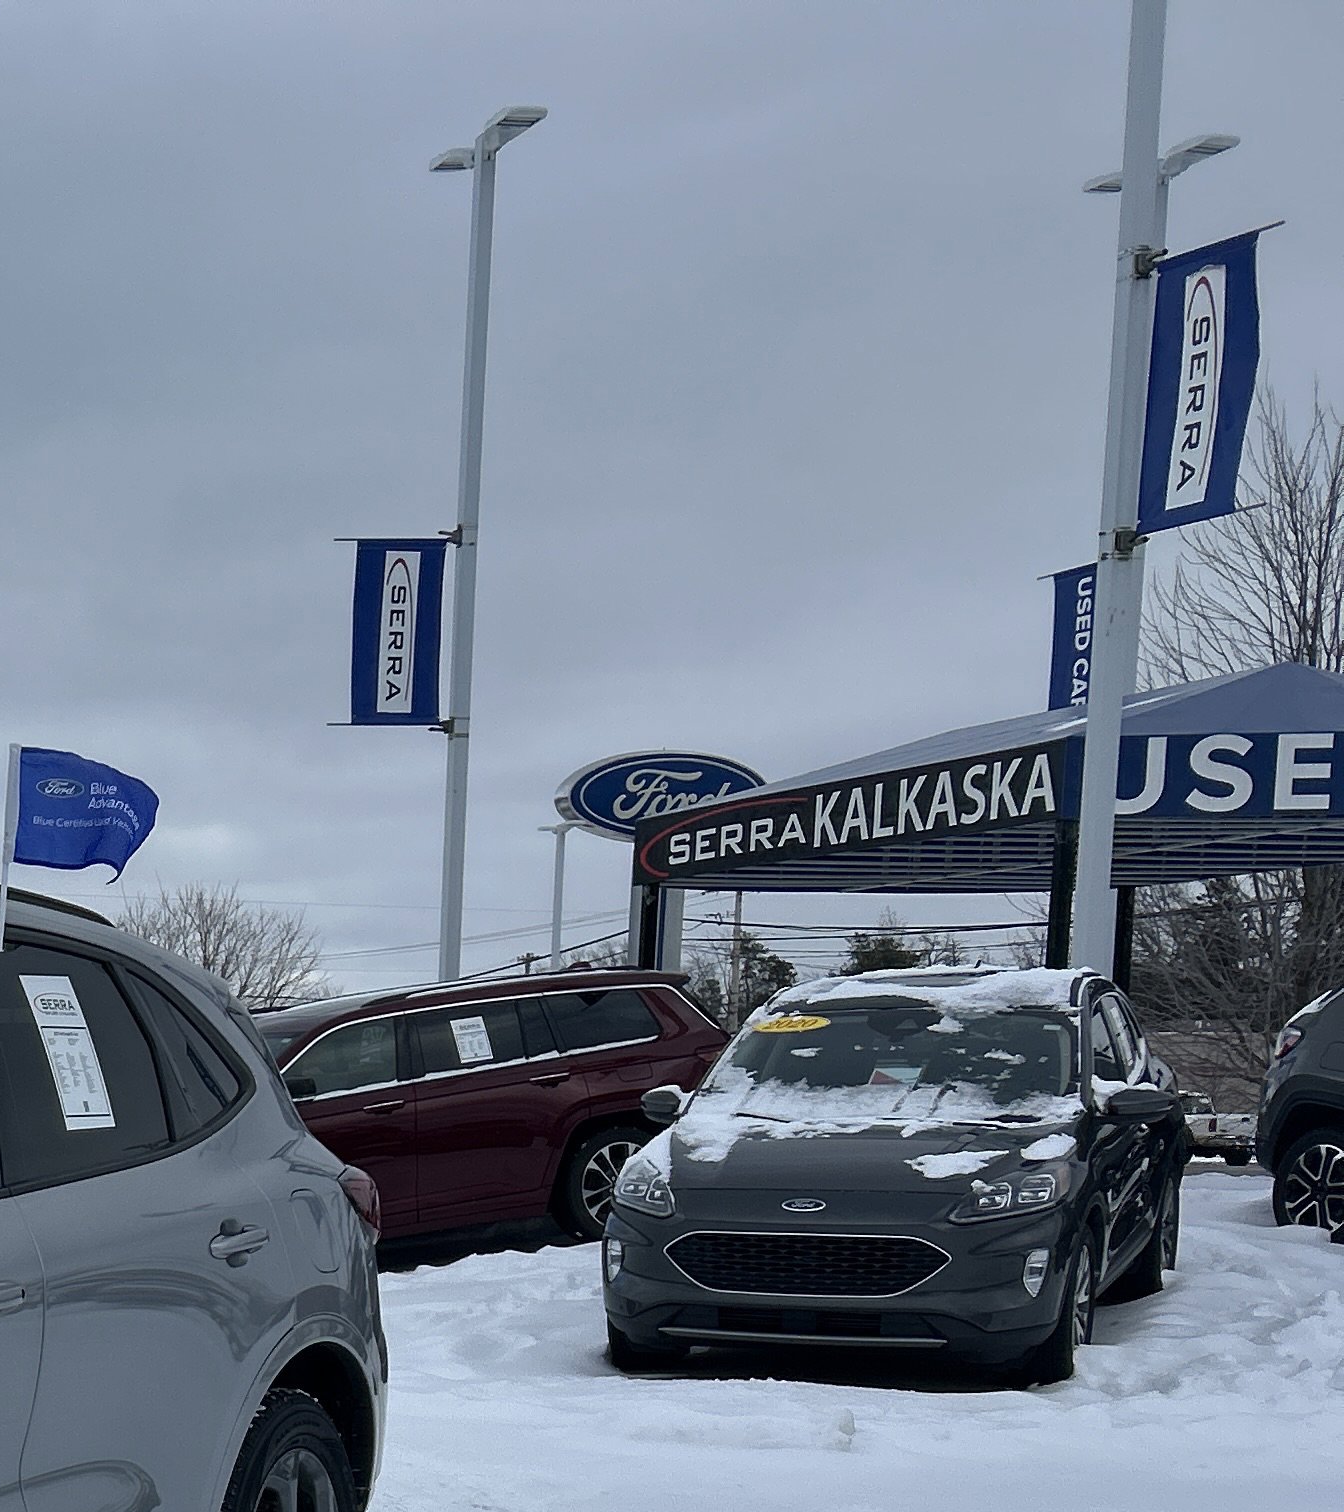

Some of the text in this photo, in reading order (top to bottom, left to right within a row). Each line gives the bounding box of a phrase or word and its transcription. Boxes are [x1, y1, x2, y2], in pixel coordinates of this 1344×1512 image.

[1176, 315, 1211, 492] SERRA
[385, 584, 407, 702] SERRA
[1074, 576, 1093, 651] USED
[44, 780, 76, 795] Ford
[90, 782, 118, 795] Blue
[668, 753, 1056, 866] SERRA KALKASKA
[40, 998, 76, 1011] SERRA
